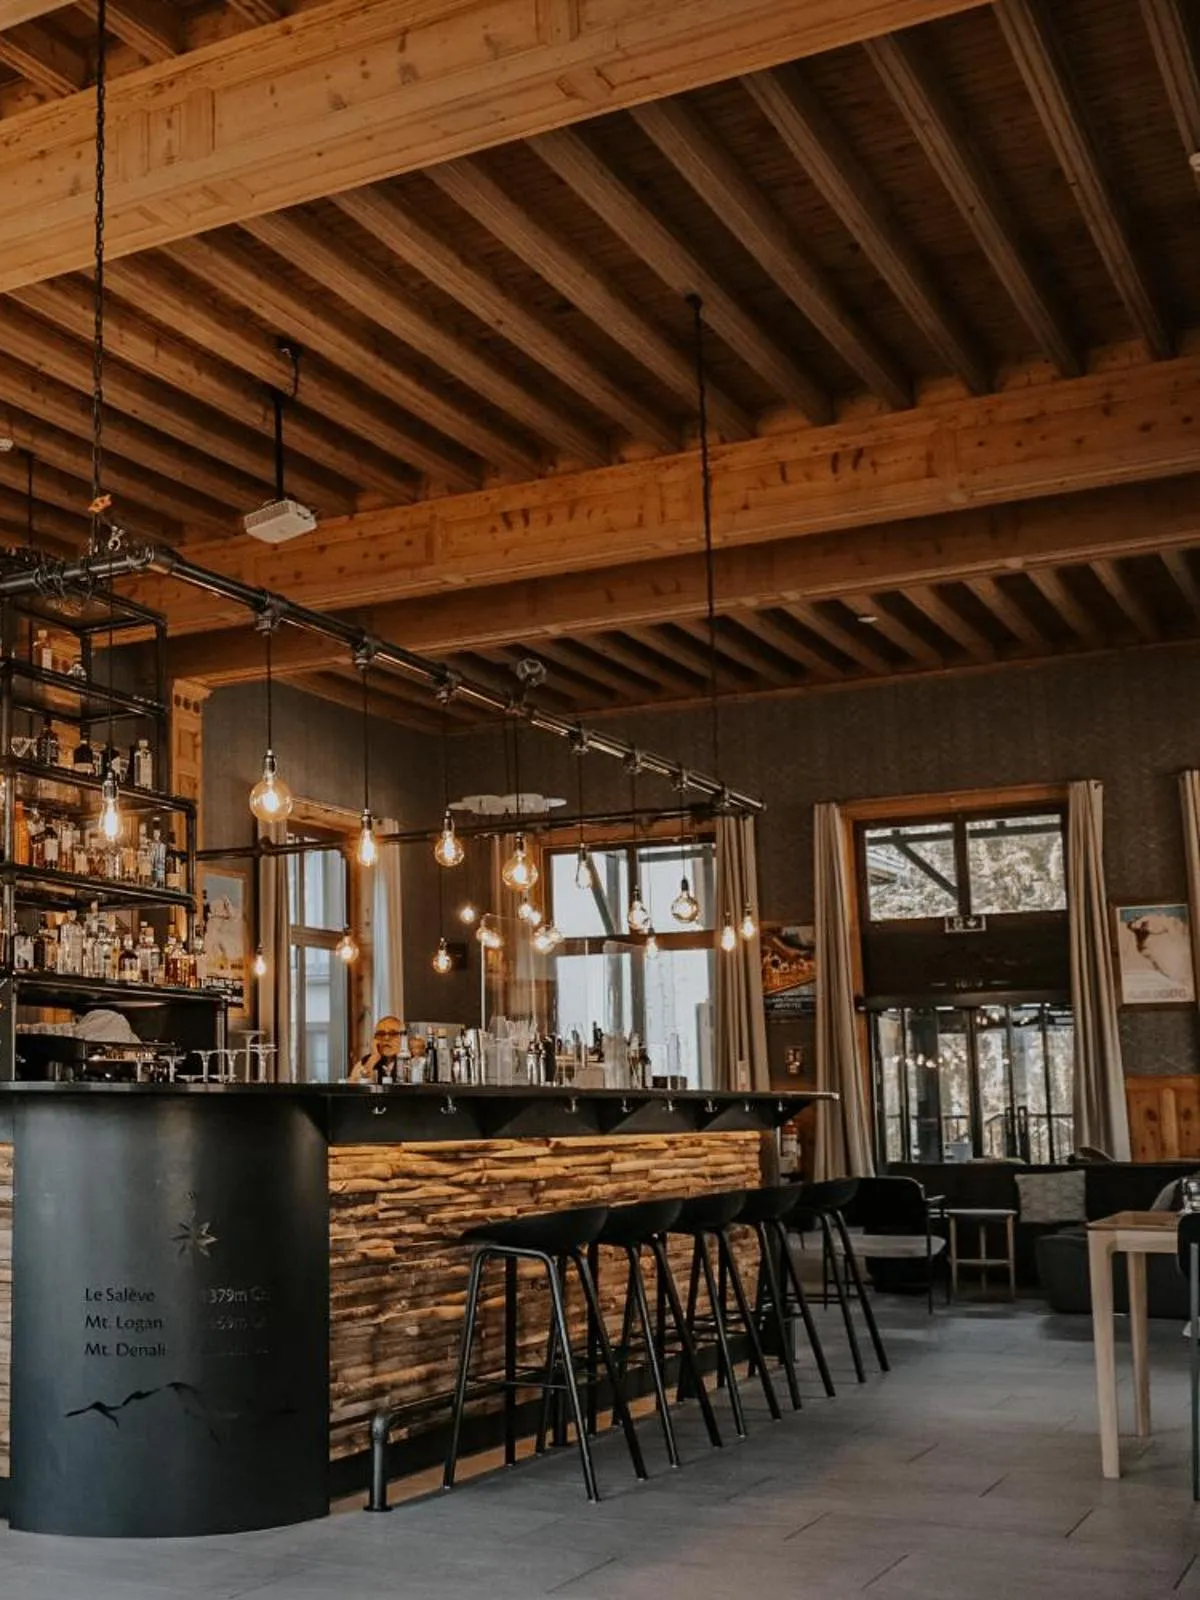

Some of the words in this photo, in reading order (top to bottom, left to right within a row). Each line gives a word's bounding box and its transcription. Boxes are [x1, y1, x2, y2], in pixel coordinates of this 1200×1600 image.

[85, 1287, 102, 1301] Le
[107, 1286, 156, 1302] Salève
[201, 1288, 248, 1303] 379m
[115, 1315, 163, 1333] Logan
[115, 1342, 166, 1357] Denali
